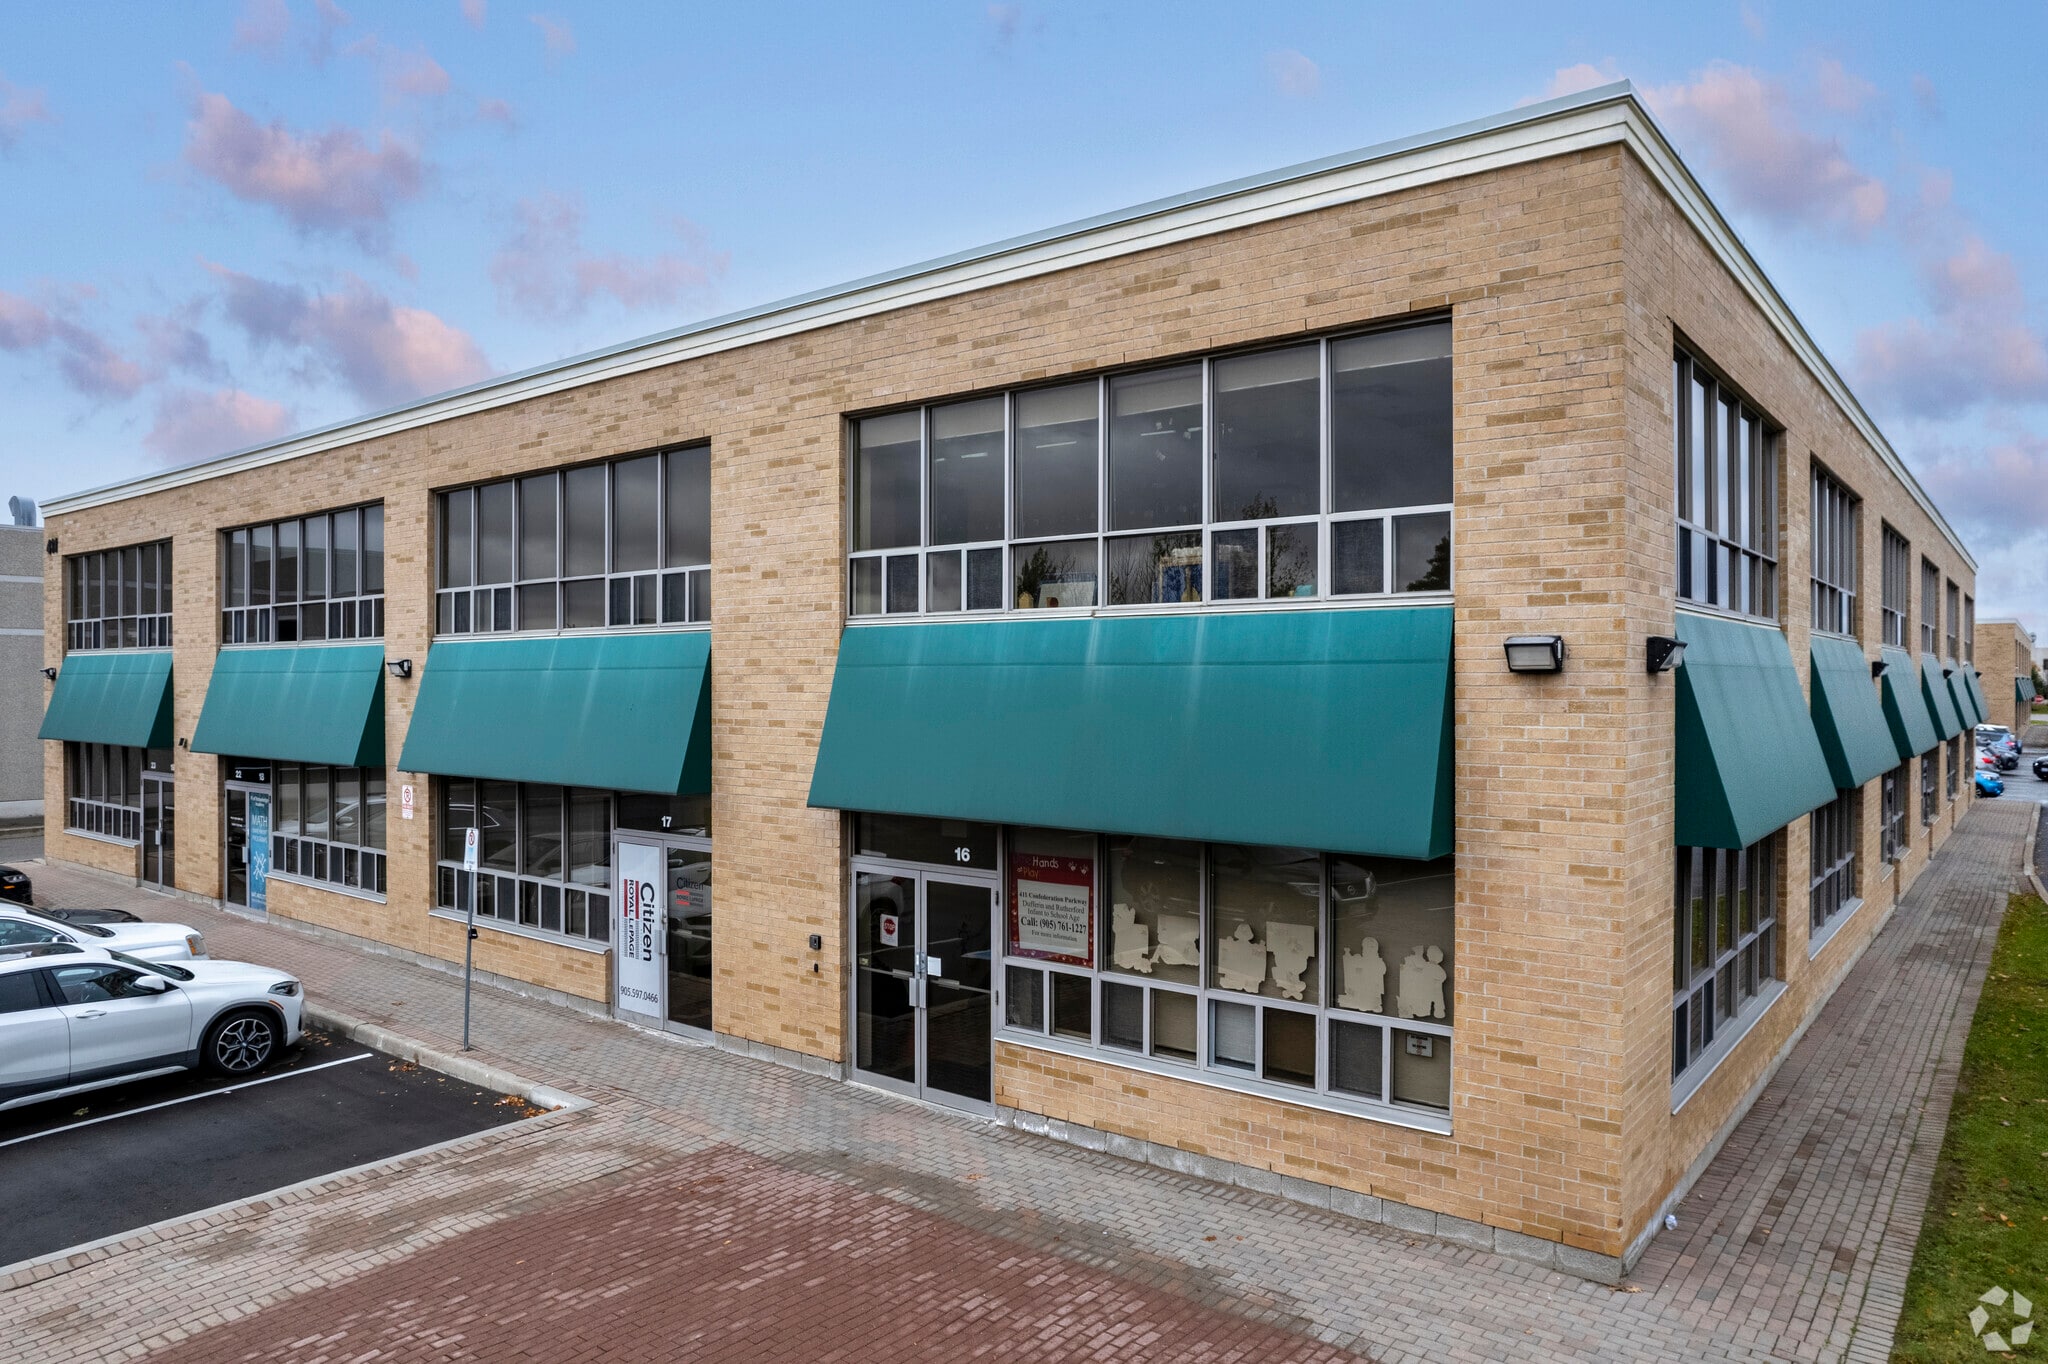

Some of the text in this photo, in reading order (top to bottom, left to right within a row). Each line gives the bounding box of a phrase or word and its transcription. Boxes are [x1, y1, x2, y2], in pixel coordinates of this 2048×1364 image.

[235, 769, 242, 779] 22
[251, 814, 268, 828] MATH
[661, 815, 672, 828] 17
[954, 846, 971, 862] 16
[1032, 855, 1059, 868] Hands
[1023, 866, 1038, 879] Play
[676, 876, 704, 891] Citizen
[1028, 892, 1063, 903] Confederation
[1064, 896, 1087, 905] Parkway
[1022, 899, 1084, 914] Dufferin and Rutherford
[640, 881, 655, 962] Citizen
[1050, 910, 1068, 920] School
[884, 922, 896, 931] STOP
[1020, 916, 1087, 934] Call: (905) 761-1227
[619, 985, 659, 1004] 905.597.0466
